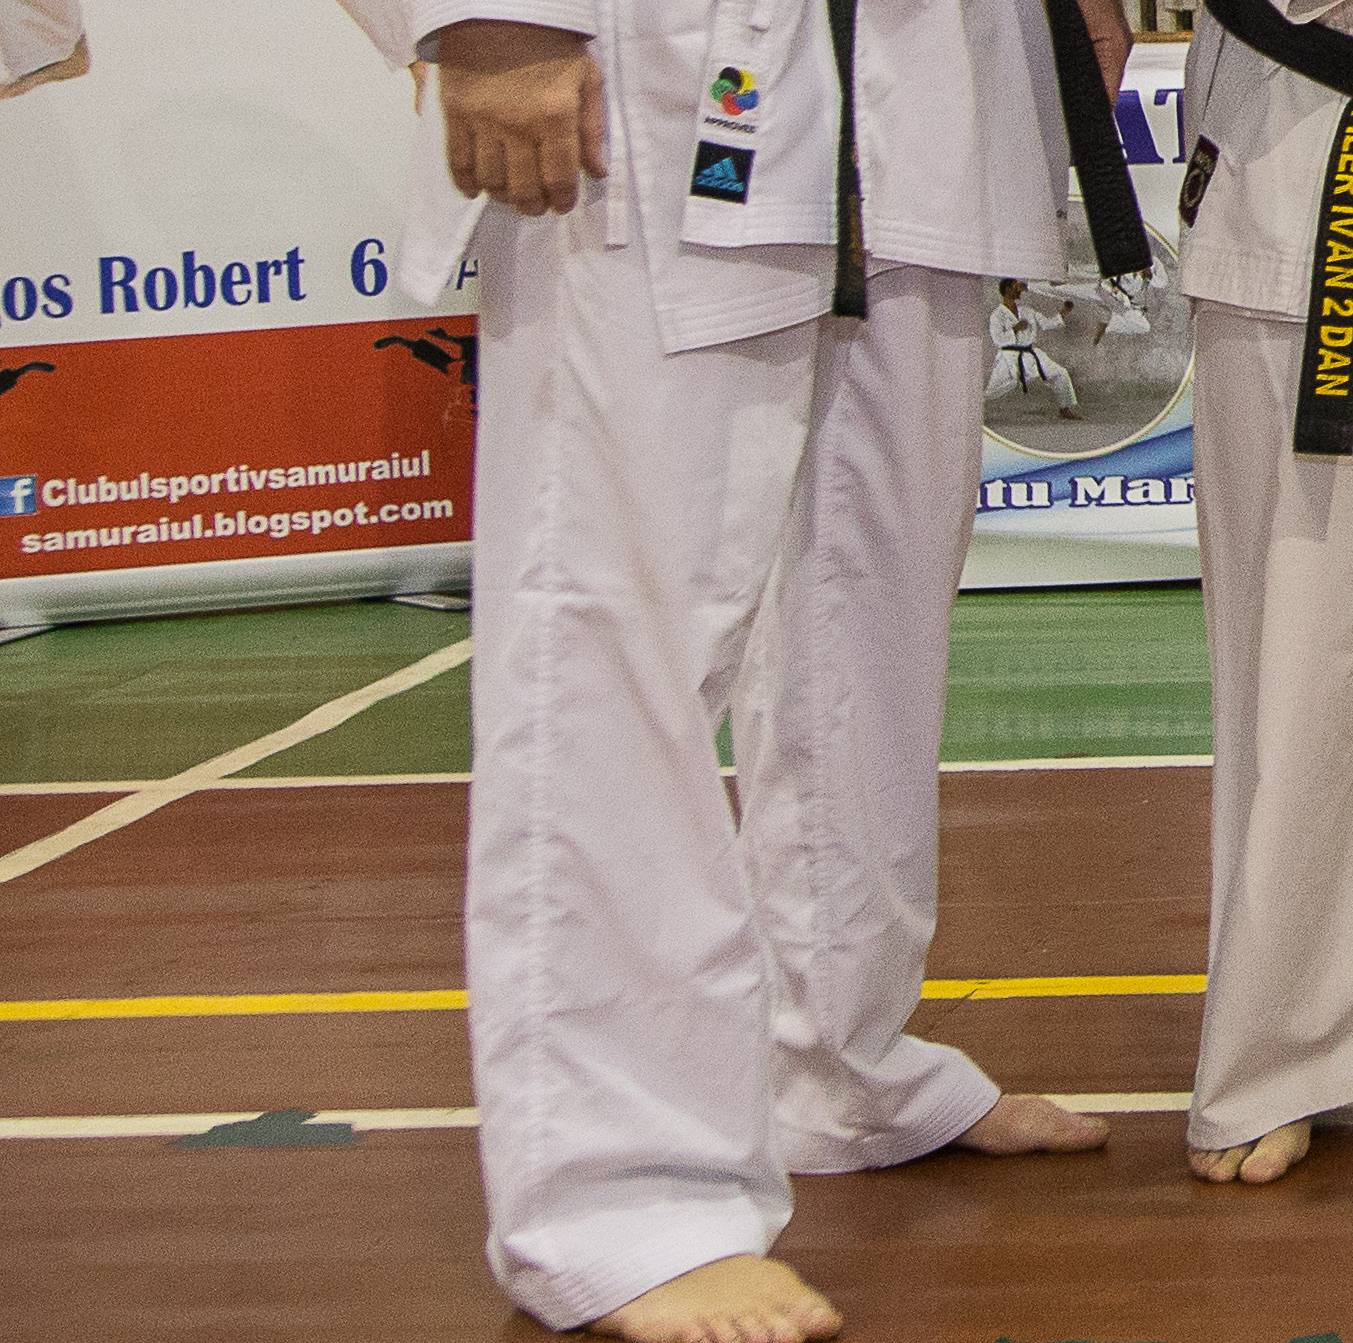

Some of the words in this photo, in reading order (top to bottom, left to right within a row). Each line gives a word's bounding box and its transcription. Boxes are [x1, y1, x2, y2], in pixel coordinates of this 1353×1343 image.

[100, 246, 307, 316] Robert
[350, 238, 389, 297] 6
[42, 449, 432, 509] Clubulsportivsamuraiul
[20, 495, 455, 556] samuraiul.blogspot.com
